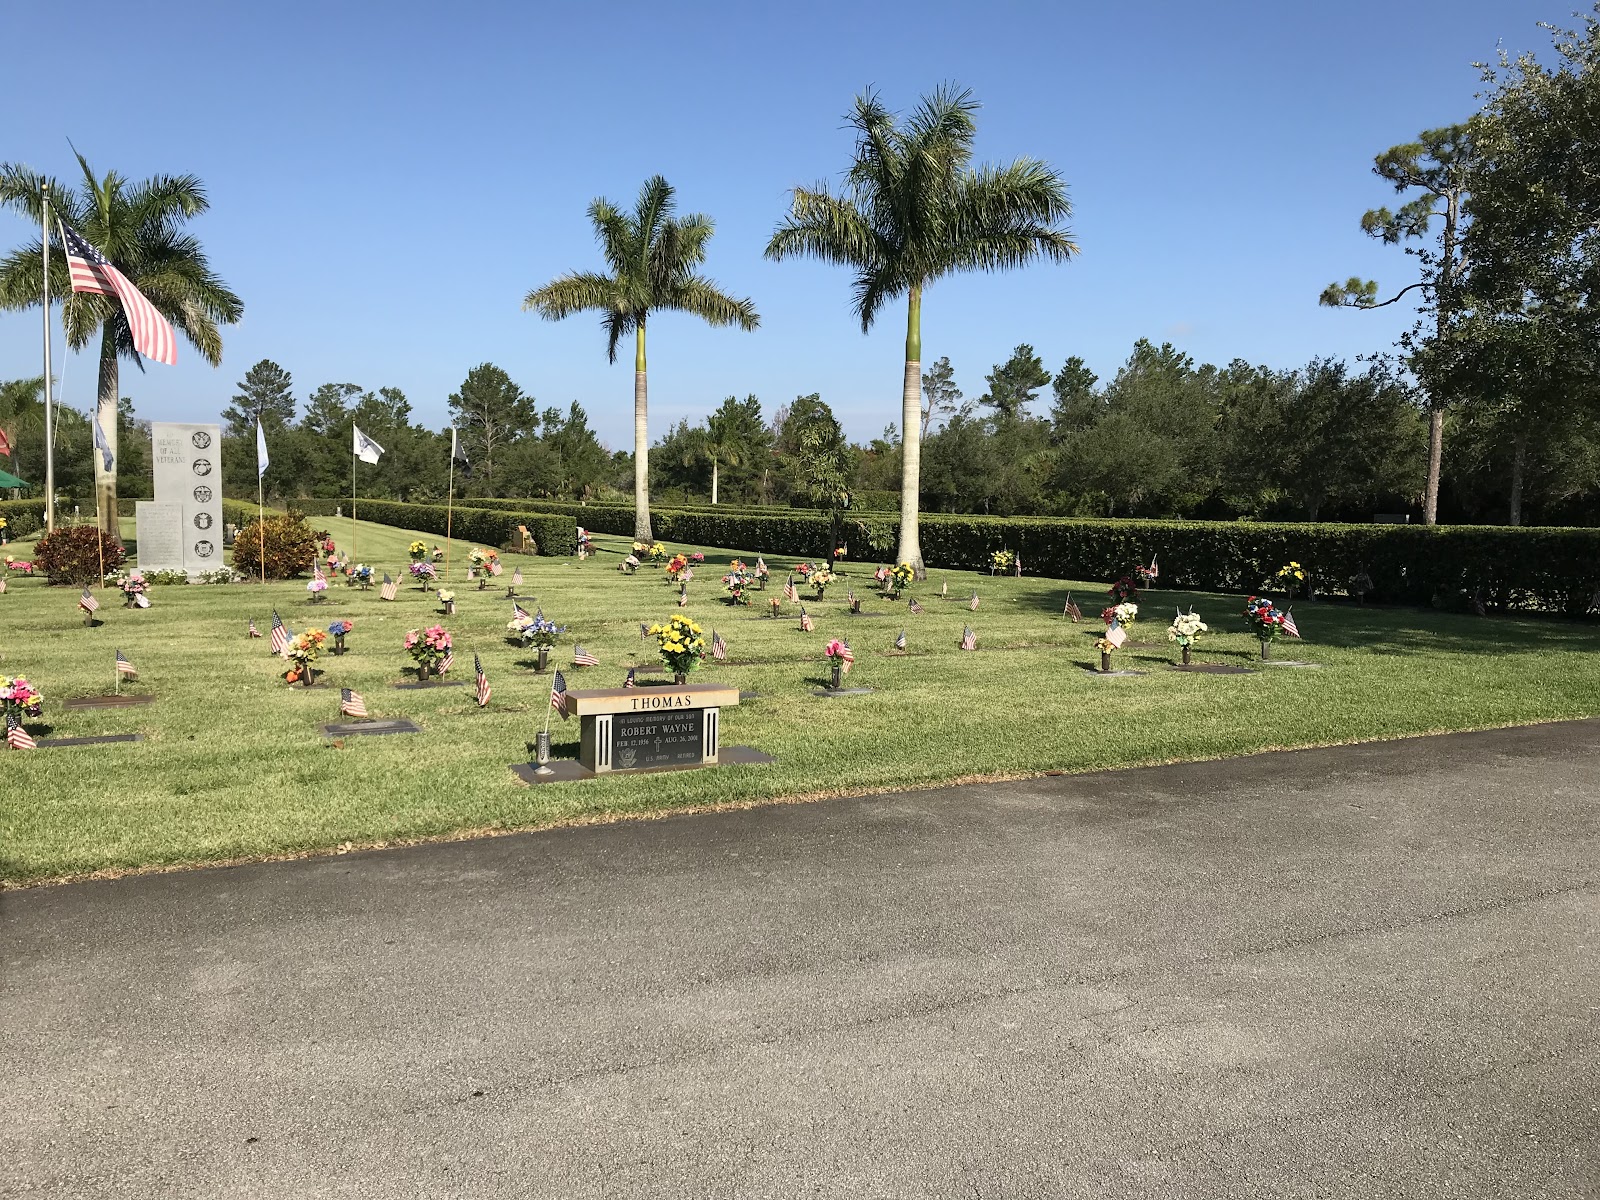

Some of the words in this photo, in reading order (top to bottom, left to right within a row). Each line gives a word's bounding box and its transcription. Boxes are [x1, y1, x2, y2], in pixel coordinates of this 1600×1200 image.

[631, 695, 691, 710] THOMAS
[621, 726, 657, 737] ROBERT
[662, 723, 694, 734] WAYNE
